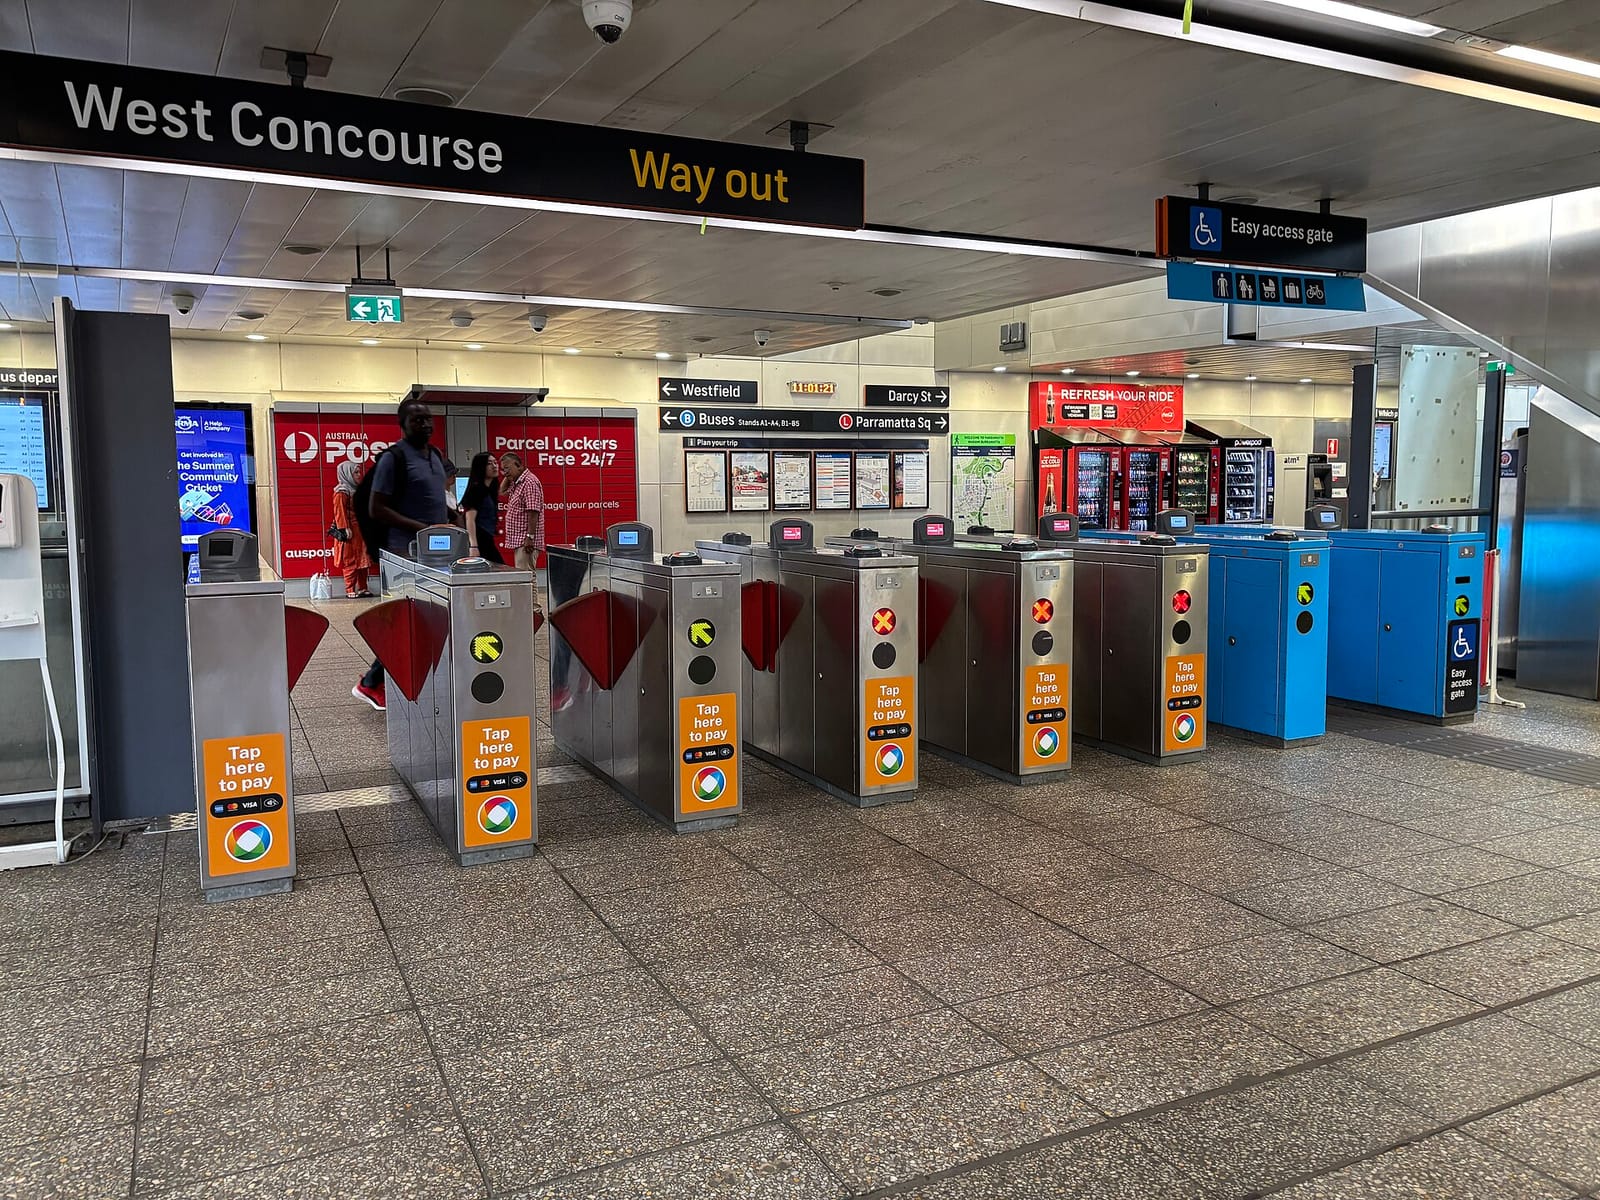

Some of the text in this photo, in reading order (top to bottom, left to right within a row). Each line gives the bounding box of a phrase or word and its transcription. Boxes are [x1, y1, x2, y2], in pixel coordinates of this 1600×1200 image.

[64, 81, 503, 173] West Concourse
[629, 149, 788, 203] Way out
[1231, 217, 1333, 244] Easy access gate
[681, 383, 740, 398] Westfield
[792, 383, 834, 393] 11:01:21
[888, 390, 932, 404] Darcy St
[1061, 389, 1174, 402] REFRESH YOUR RIDE
[699, 413, 735, 426] Buses
[760, 419, 781, 428] A1-A4,
[856, 416, 916, 428] Parramatta
[918, 417, 931, 431] Sq
[325, 432, 369, 440] AUSTRALIA
[495, 436, 618, 450] Parcel Lockers
[697, 438, 738, 448] Plan your trip
[192, 461, 235, 470] Summer
[538, 452, 616, 467] Free 24/7
[180, 472, 239, 483] Community
[185, 483, 223, 492] Cricket
[567, 501, 586, 511] your
[588, 500, 620, 510] parcels
[1177, 662, 1193, 672] Tap
[1038, 672, 1056, 683] Tap
[1175, 673, 1195, 682] here
[1451, 668, 1466, 679] Easy
[1036, 683, 1058, 694] here
[1172, 683, 1198, 694] to pay
[1451, 678, 1473, 688] access
[880, 685, 900, 697] Tap
[1450, 690, 1465, 700] gate
[877, 697, 902, 708] here
[1032, 695, 1061, 706] to pay
[696, 703, 720, 716] Tap
[873, 709, 906, 721] to pay
[694, 717, 722, 729] here
[482, 728, 510, 743] Tap
[689, 729, 728, 742] to pay
[228, 746, 261, 760] Tap
[479, 742, 513, 755] here
[225, 761, 266, 776] here
[473, 756, 520, 770] to pay
[218, 776, 273, 792] to pay
[242, 801, 258, 809] VISA
